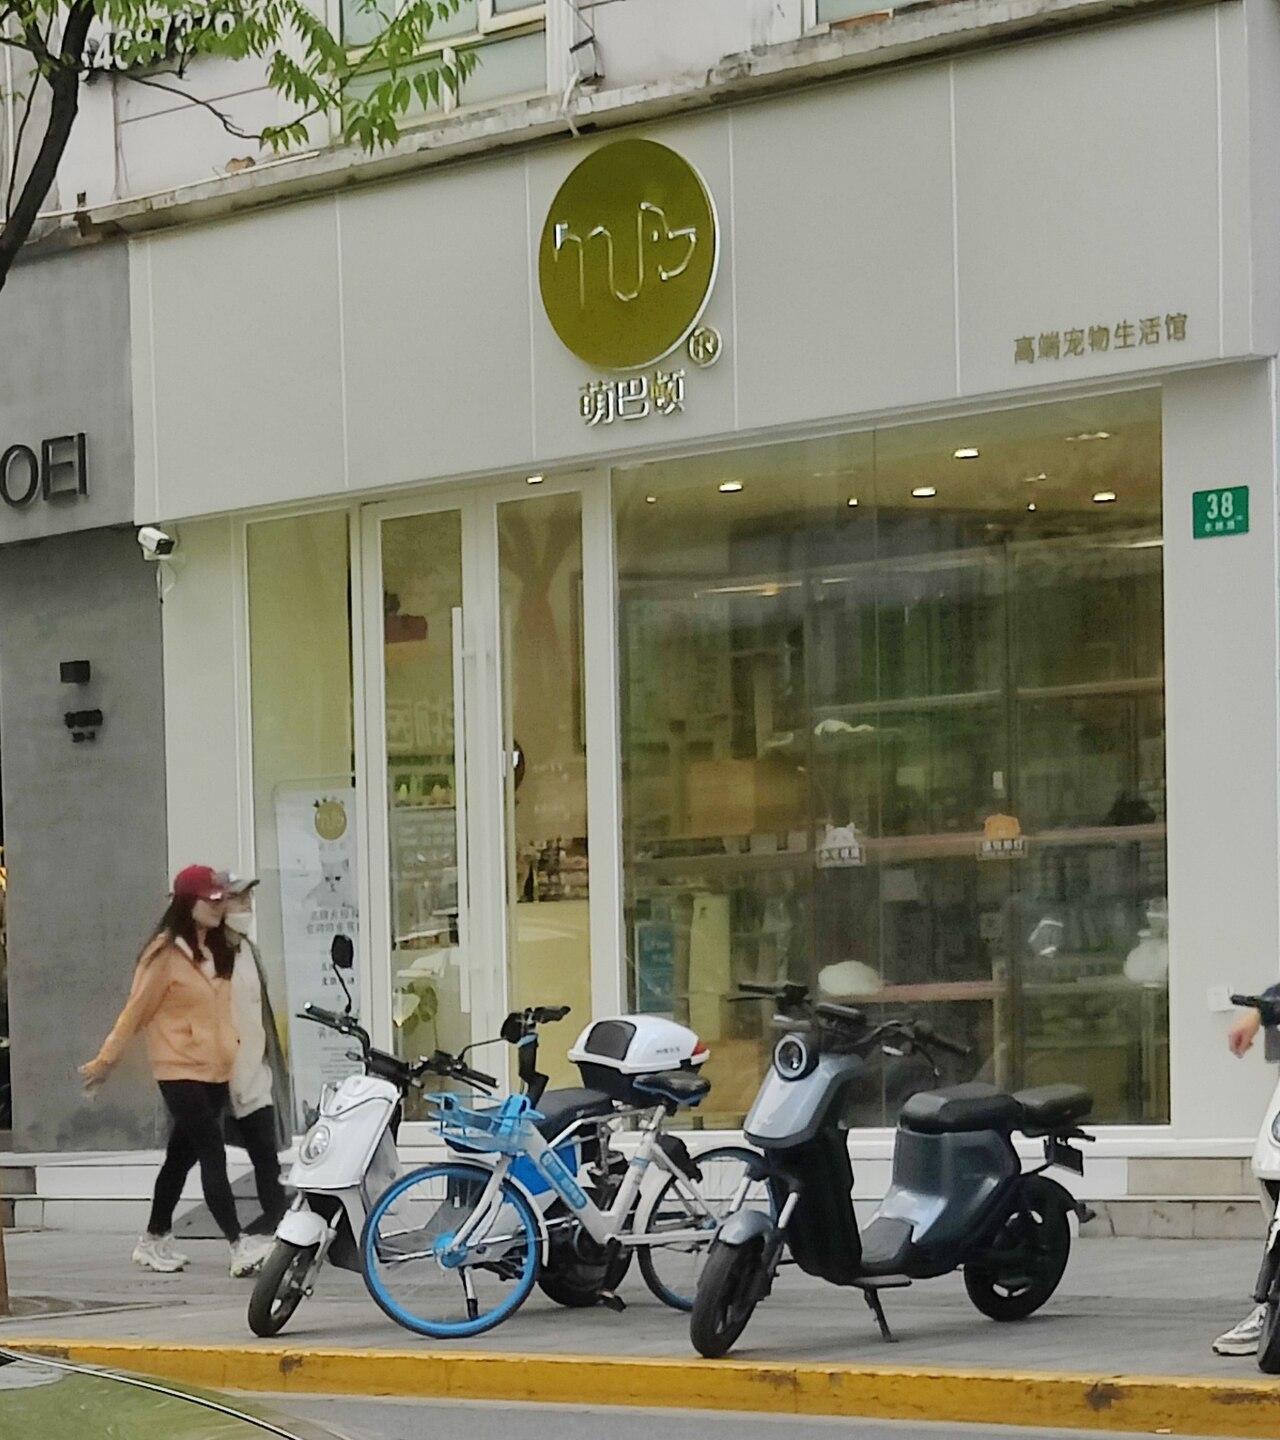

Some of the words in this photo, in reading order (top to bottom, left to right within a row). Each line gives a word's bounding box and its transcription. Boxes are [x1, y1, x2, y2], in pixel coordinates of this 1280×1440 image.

[1014, 312, 1188, 365] 高端宠物生活馆
[1206, 491, 1234, 520] 38
